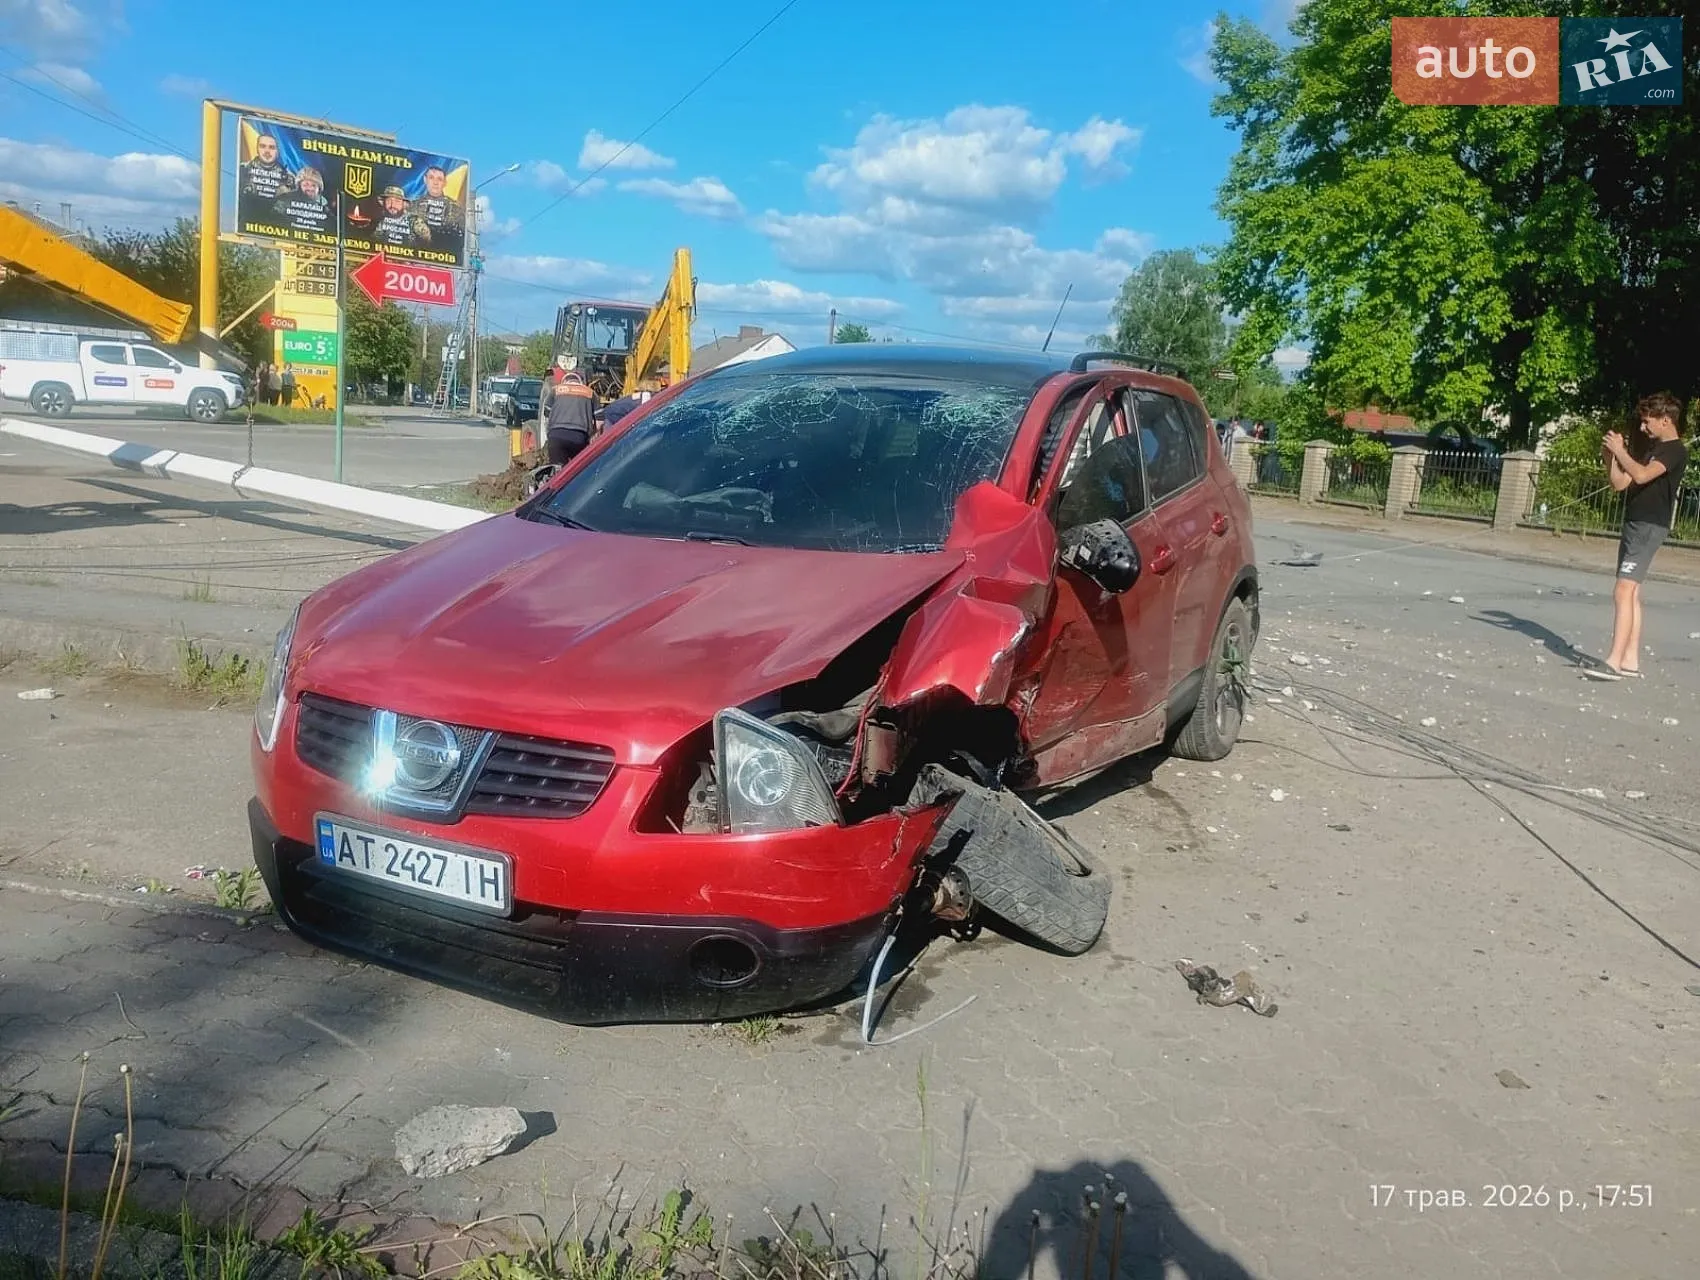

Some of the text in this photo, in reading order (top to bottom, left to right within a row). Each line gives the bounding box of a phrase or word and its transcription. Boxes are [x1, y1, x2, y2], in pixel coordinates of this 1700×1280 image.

[302, 139, 412, 169] ВІЧНА ПАМ'ЯТЬ
[245, 223, 289, 237] НІКОЛИ
[294, 230, 309, 241] НЕ
[375, 243, 414, 256] НАШИХ
[418, 250, 456, 263] ГЕРОЇВ
[284, 340, 326, 355] EURO 5
[322, 847, 334, 860] UA
[338, 832, 500, 901] AT 2427 IH
